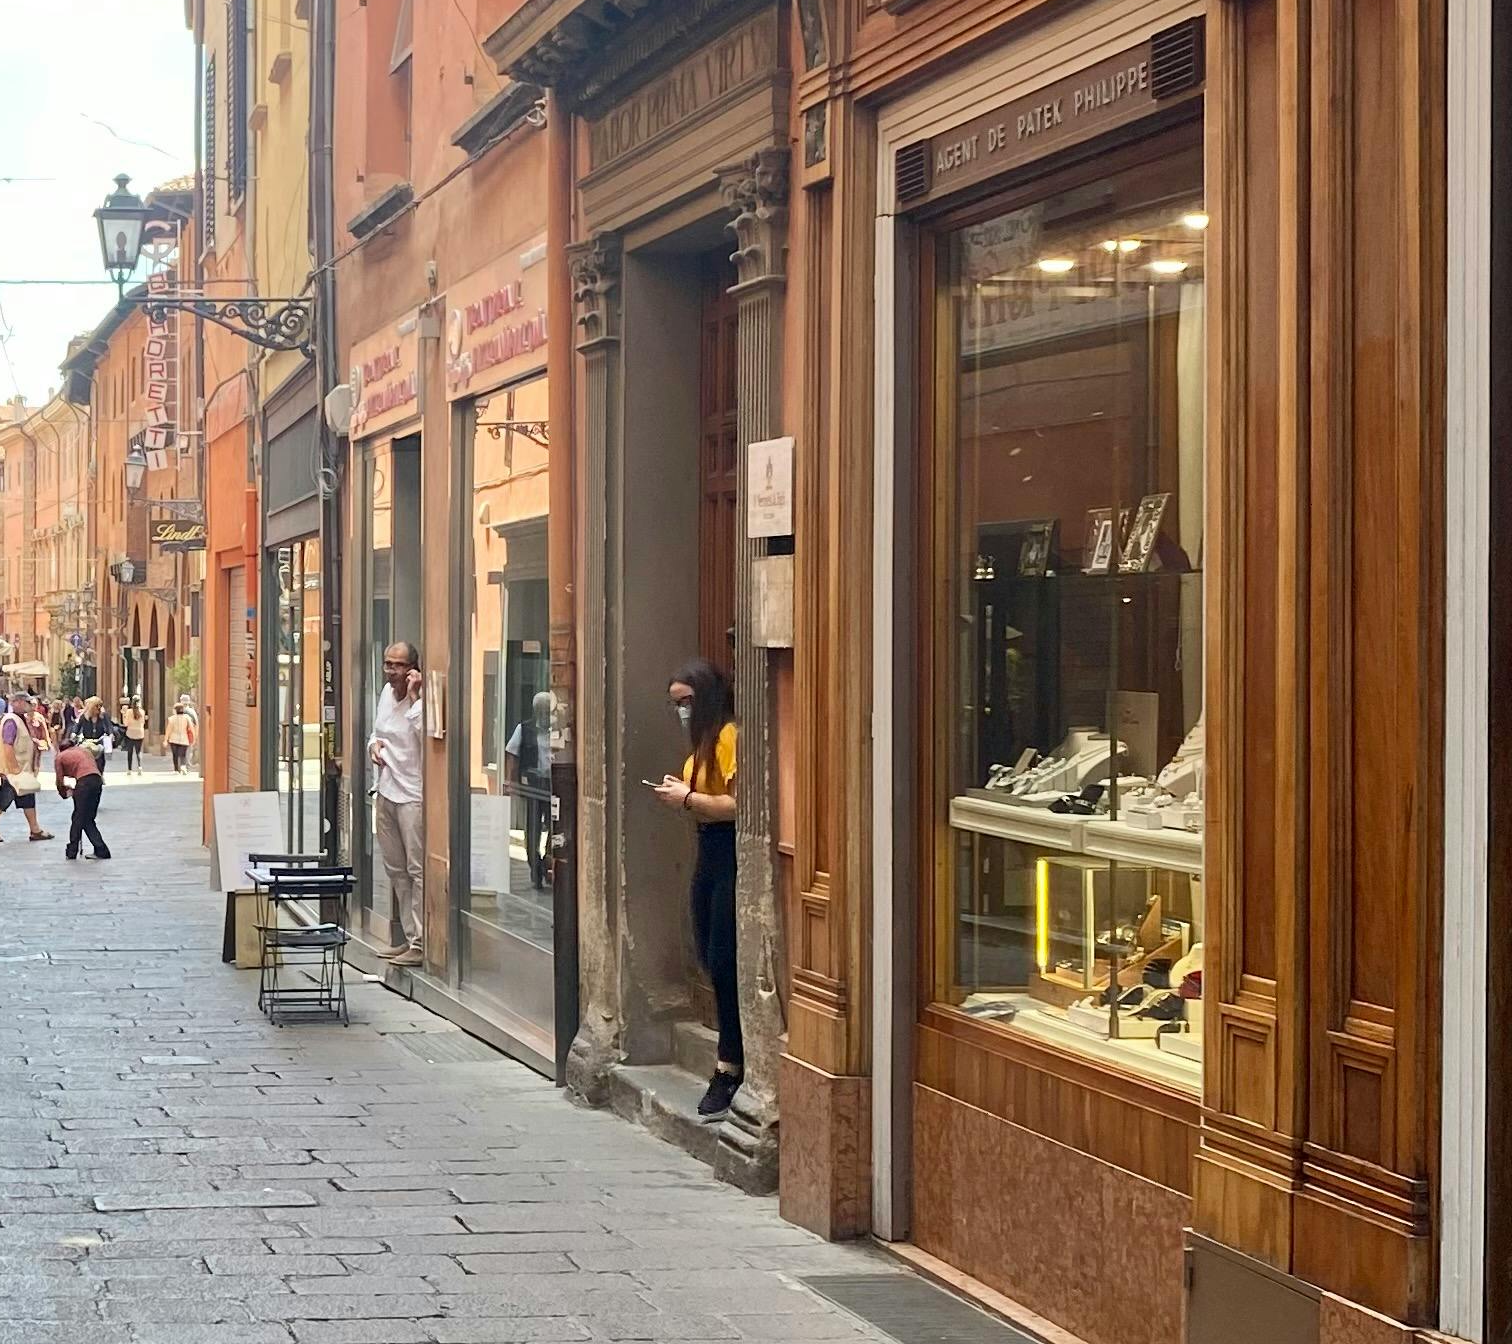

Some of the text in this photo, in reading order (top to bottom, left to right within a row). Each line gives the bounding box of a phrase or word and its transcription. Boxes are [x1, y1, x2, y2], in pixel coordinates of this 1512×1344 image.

[936, 61, 1148, 175] AGENT DE PATEK PHILIPPE
[151, 523, 203, 541] Lindt
